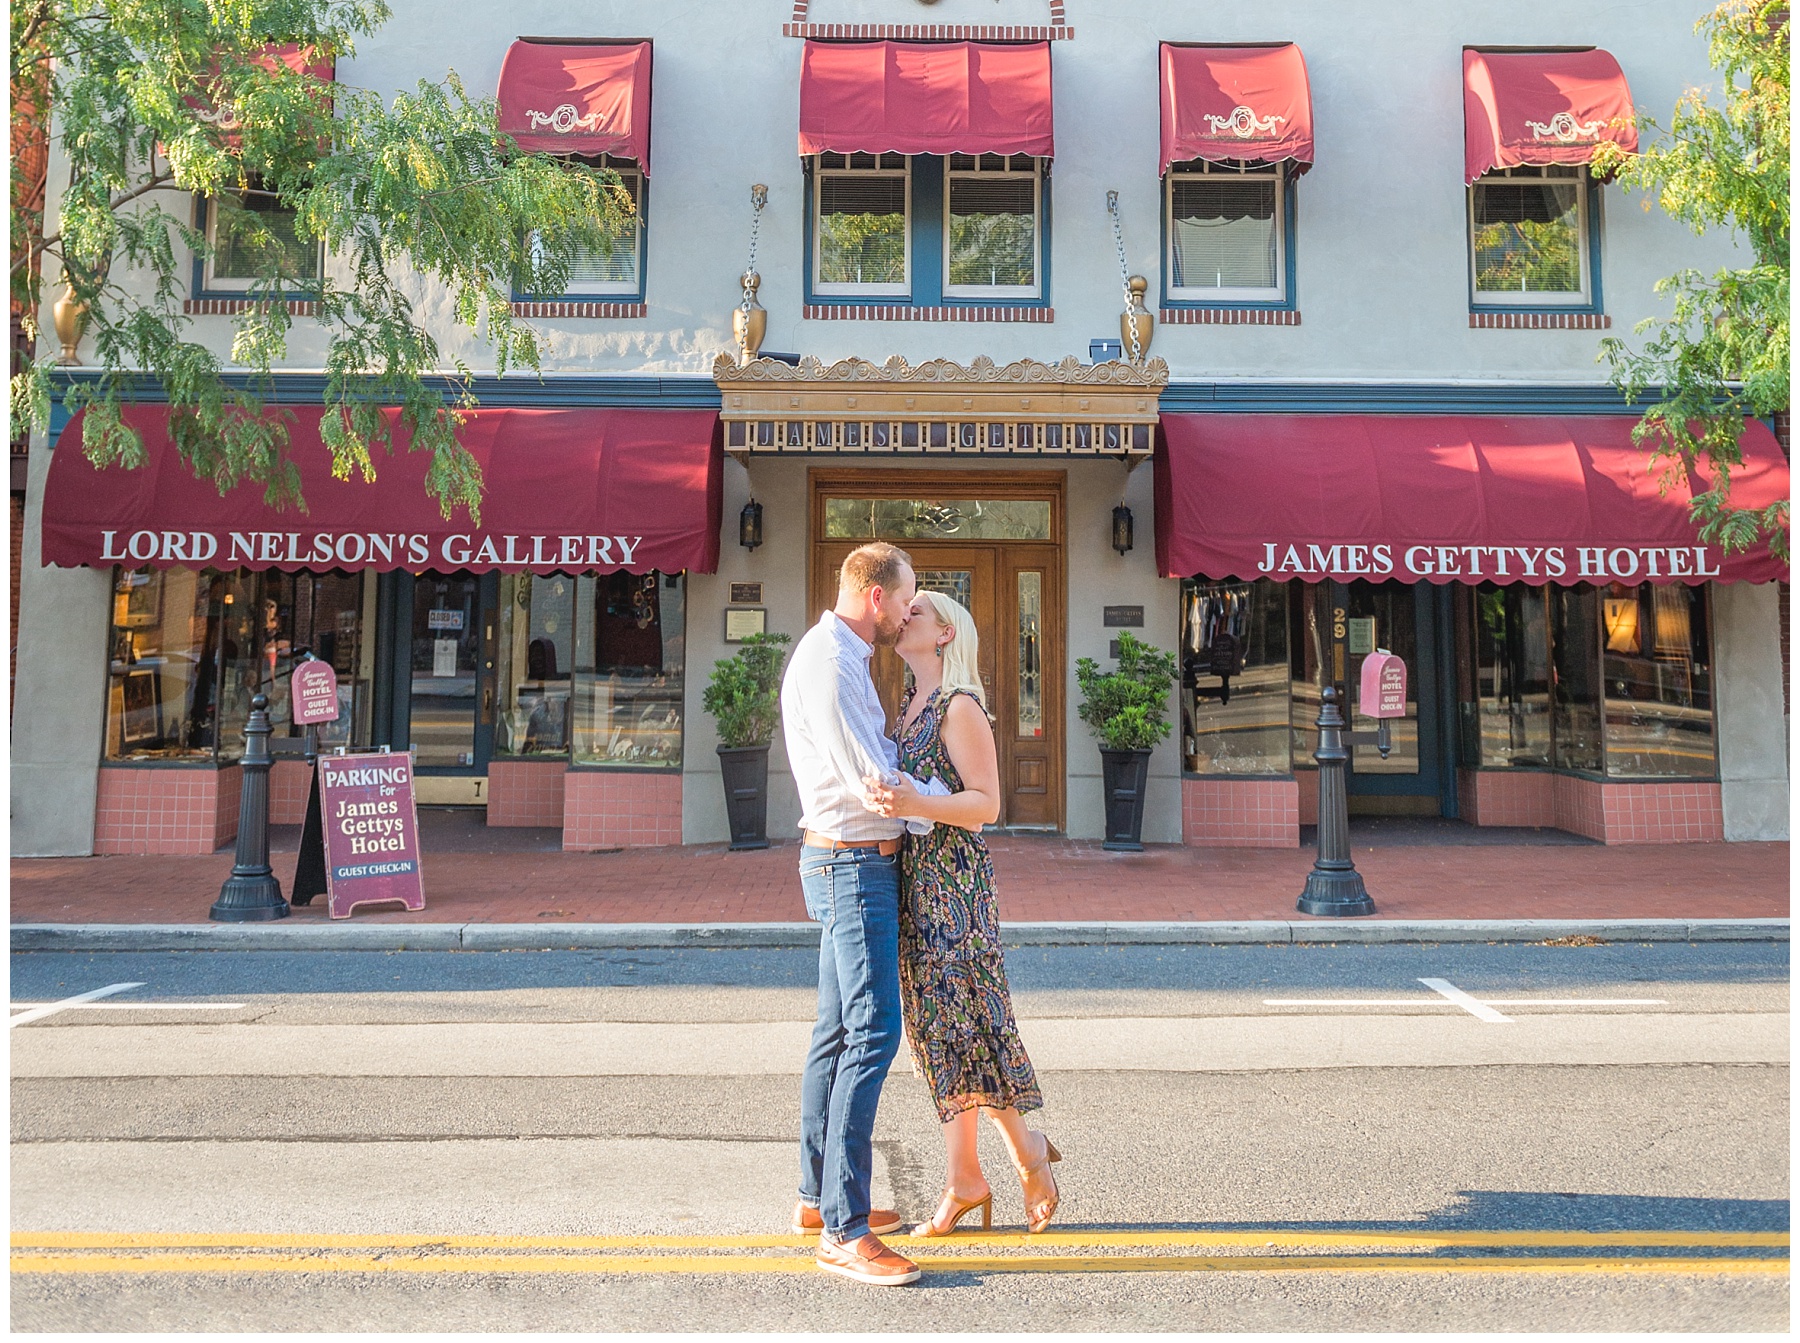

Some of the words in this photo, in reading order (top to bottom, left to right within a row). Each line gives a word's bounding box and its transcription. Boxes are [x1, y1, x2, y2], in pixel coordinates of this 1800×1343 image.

[761, 423, 886, 447] JAMES
[961, 423, 1118, 448] GETTYS
[99, 530, 218, 561] LORD
[227, 531, 430, 564] NELSON'S
[441, 534, 643, 565] GALLERY
[1257, 542, 1394, 574] JAMES
[1404, 545, 1567, 577] GETTYS
[1576, 546, 1721, 577] HOTEL
[303, 686, 331, 697] HOTEL
[304, 706, 334, 717] CHECK-IN
[308, 699, 329, 709] GUEST
[325, 767, 408, 788] PARKING
[380, 785, 396, 796] For
[336, 800, 398, 818] James
[341, 817, 404, 838] Gettys
[350, 833, 406, 854] Hotel
[338, 866, 367, 877] GUEST
[369, 862, 411, 875] CHECK-IN
